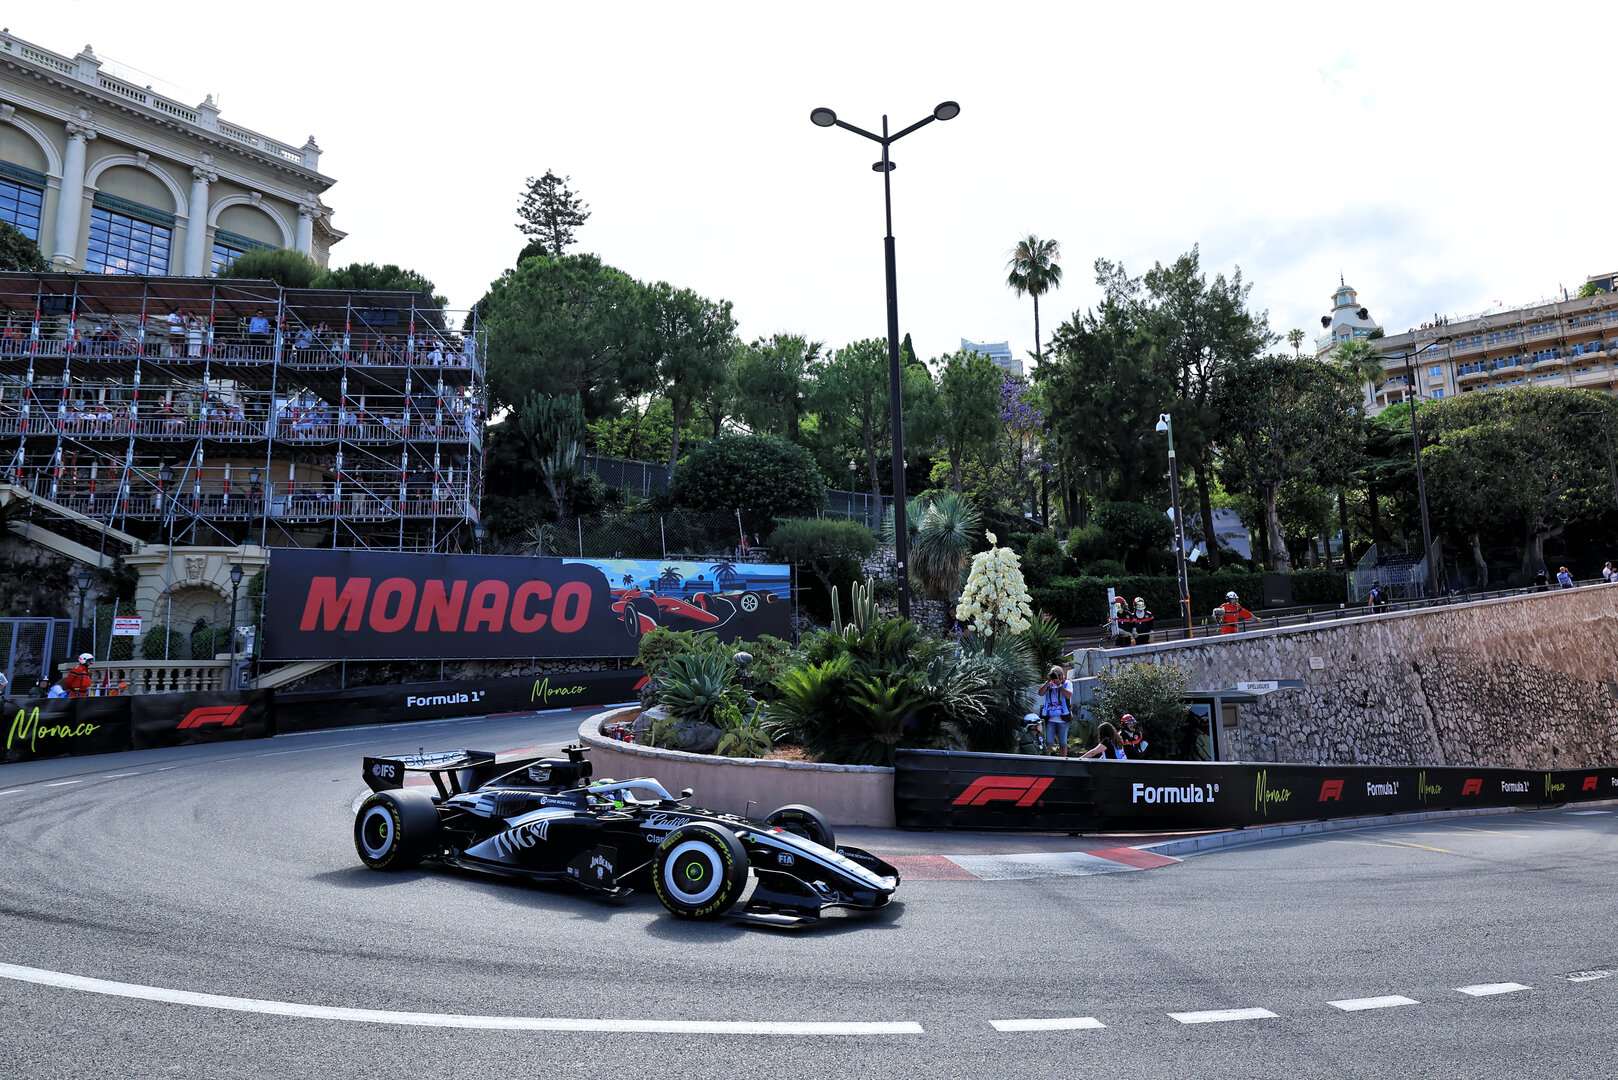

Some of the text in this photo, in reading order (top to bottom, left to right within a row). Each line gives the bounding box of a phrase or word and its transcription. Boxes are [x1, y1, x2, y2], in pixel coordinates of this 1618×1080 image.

[300, 576, 593, 633] MONACO
[531, 677, 587, 704] Monaco
[407, 692, 469, 707] Formula
[7, 706, 100, 752] Monaco
[380, 764, 395, 778] IFS
[1132, 783, 1204, 804] Formula
[1255, 769, 1291, 816] Monaco
[1366, 781, 1393, 796] Formula
[1501, 780, 1523, 793] Formula
[649, 813, 691, 827] Cadill
[646, 832, 666, 844] Clar
[778, 854, 794, 864] FIA
